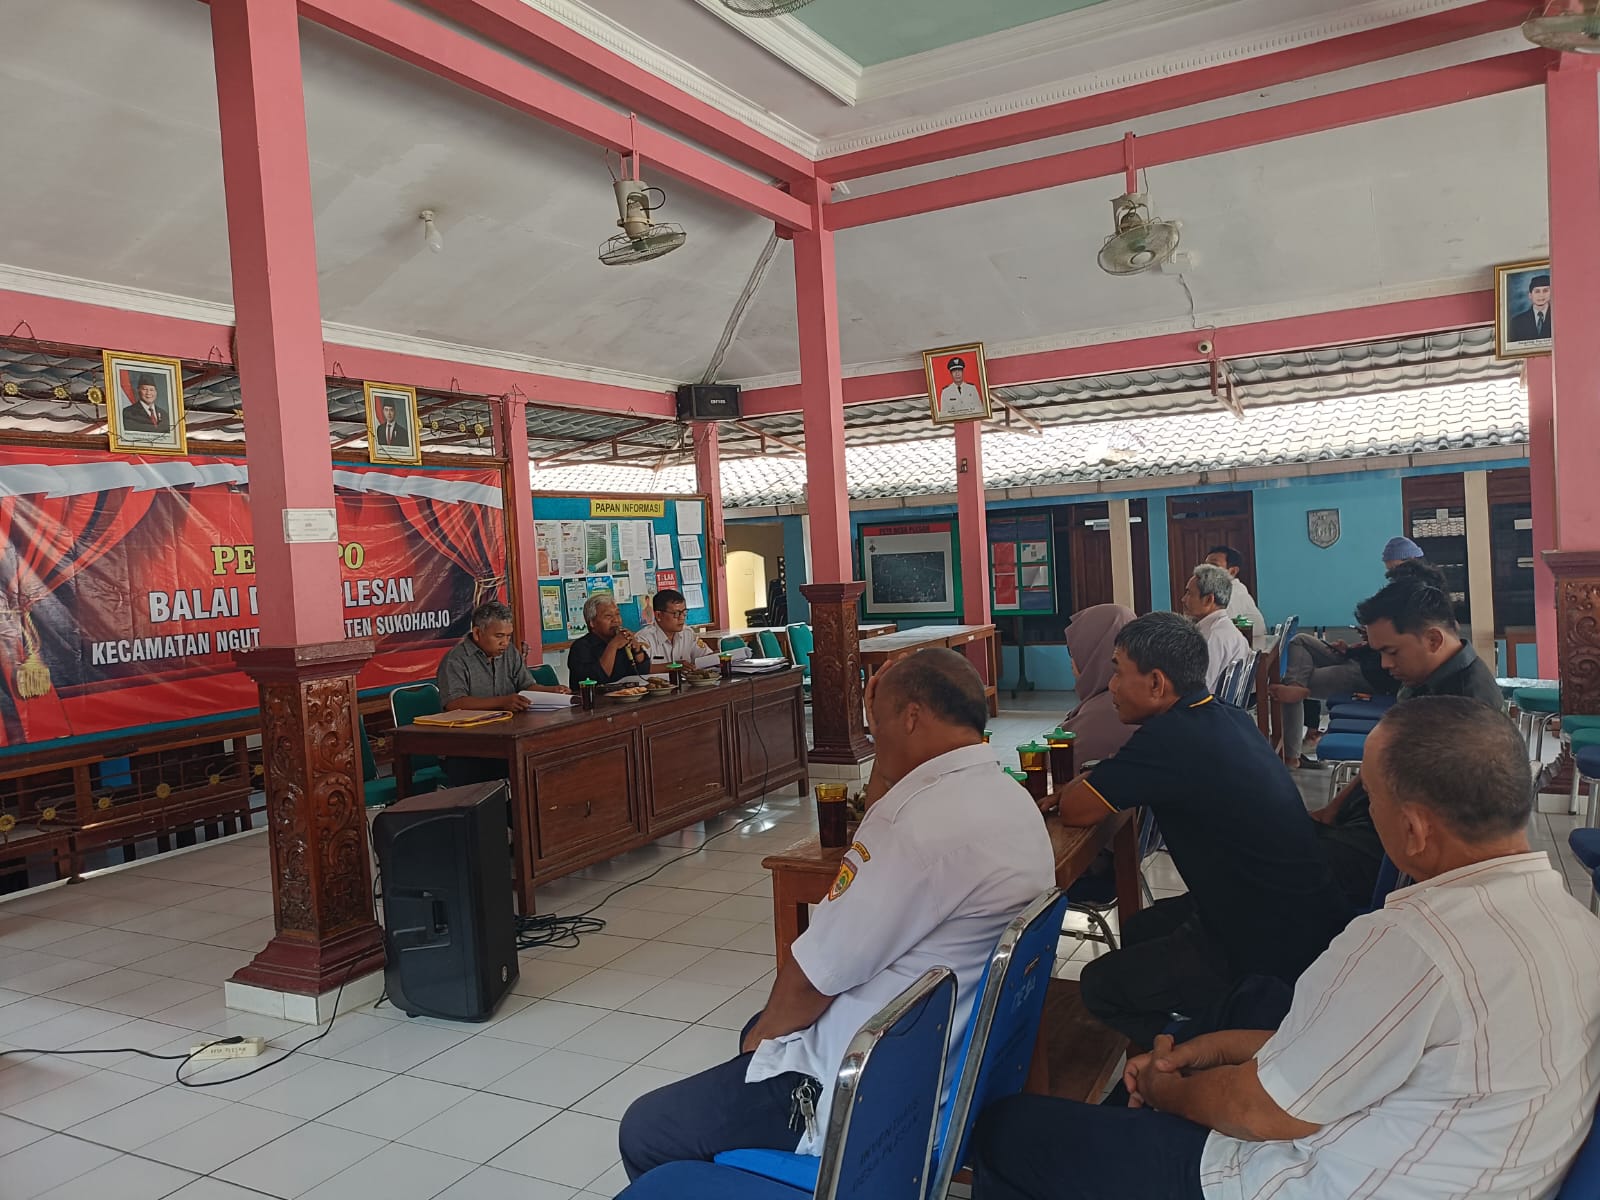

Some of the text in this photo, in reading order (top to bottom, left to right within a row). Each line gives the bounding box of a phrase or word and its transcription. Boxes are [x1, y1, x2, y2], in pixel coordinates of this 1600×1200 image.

[595, 503, 661, 513] PAPAN INFORMASI
[148, 587, 240, 623] BALAI
[343, 576, 415, 608] LESAN
[91, 632, 211, 666] KECAMATAN
[215, 628, 260, 653] NGUT
[375, 609, 451, 636] SUKOHARJO
